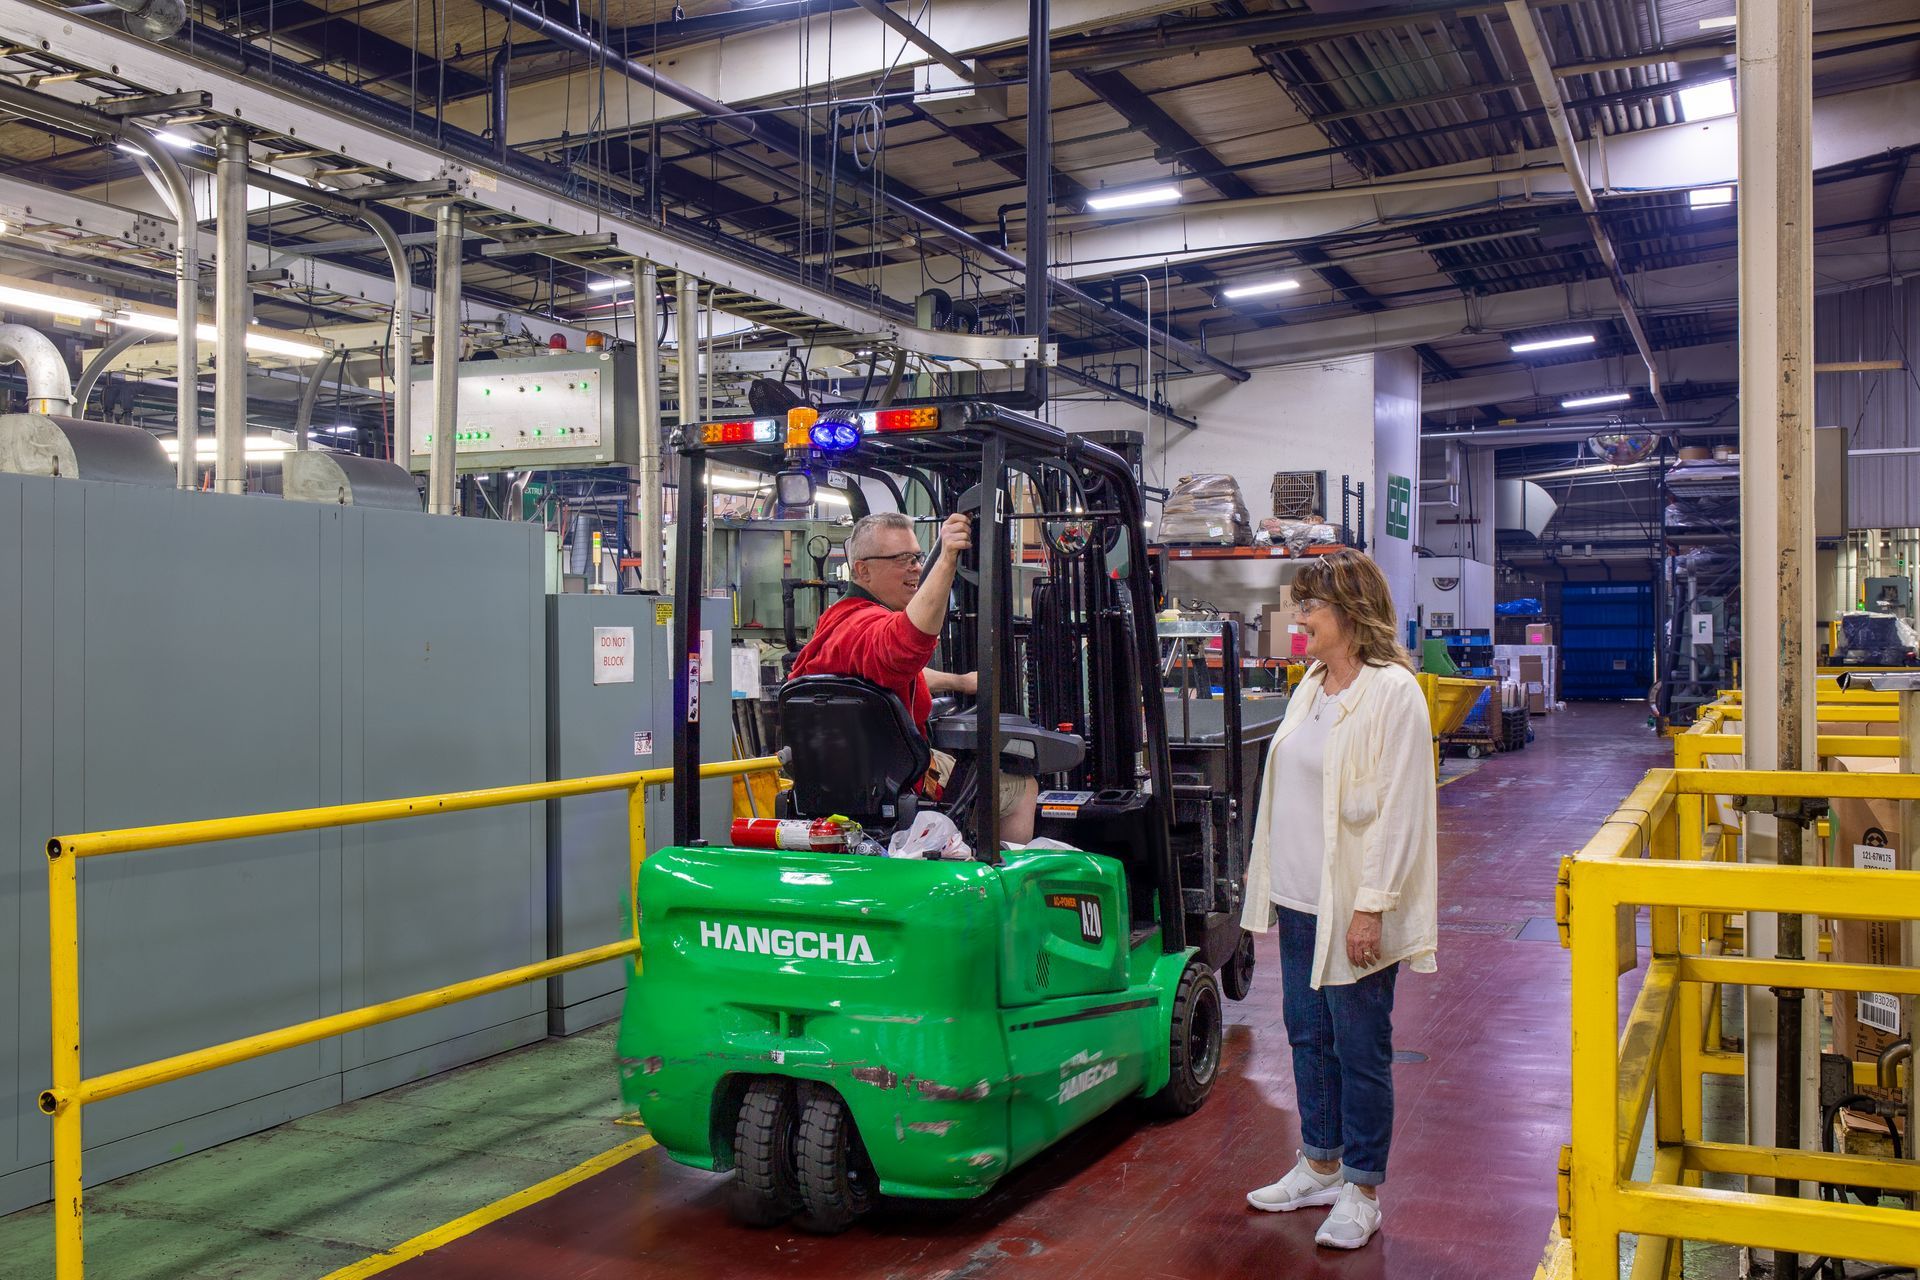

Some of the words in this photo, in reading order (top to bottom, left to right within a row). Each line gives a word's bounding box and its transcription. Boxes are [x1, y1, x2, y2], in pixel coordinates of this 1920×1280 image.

[996, 490, 1003, 521] 4
[1698, 621, 1707, 634] F
[601, 637, 612, 647] DO
[612, 637, 626, 647] NOT
[603, 656, 624, 666] BLOCK
[1080, 900, 1102, 938] A20
[700, 920, 874, 962] HANGCHA
